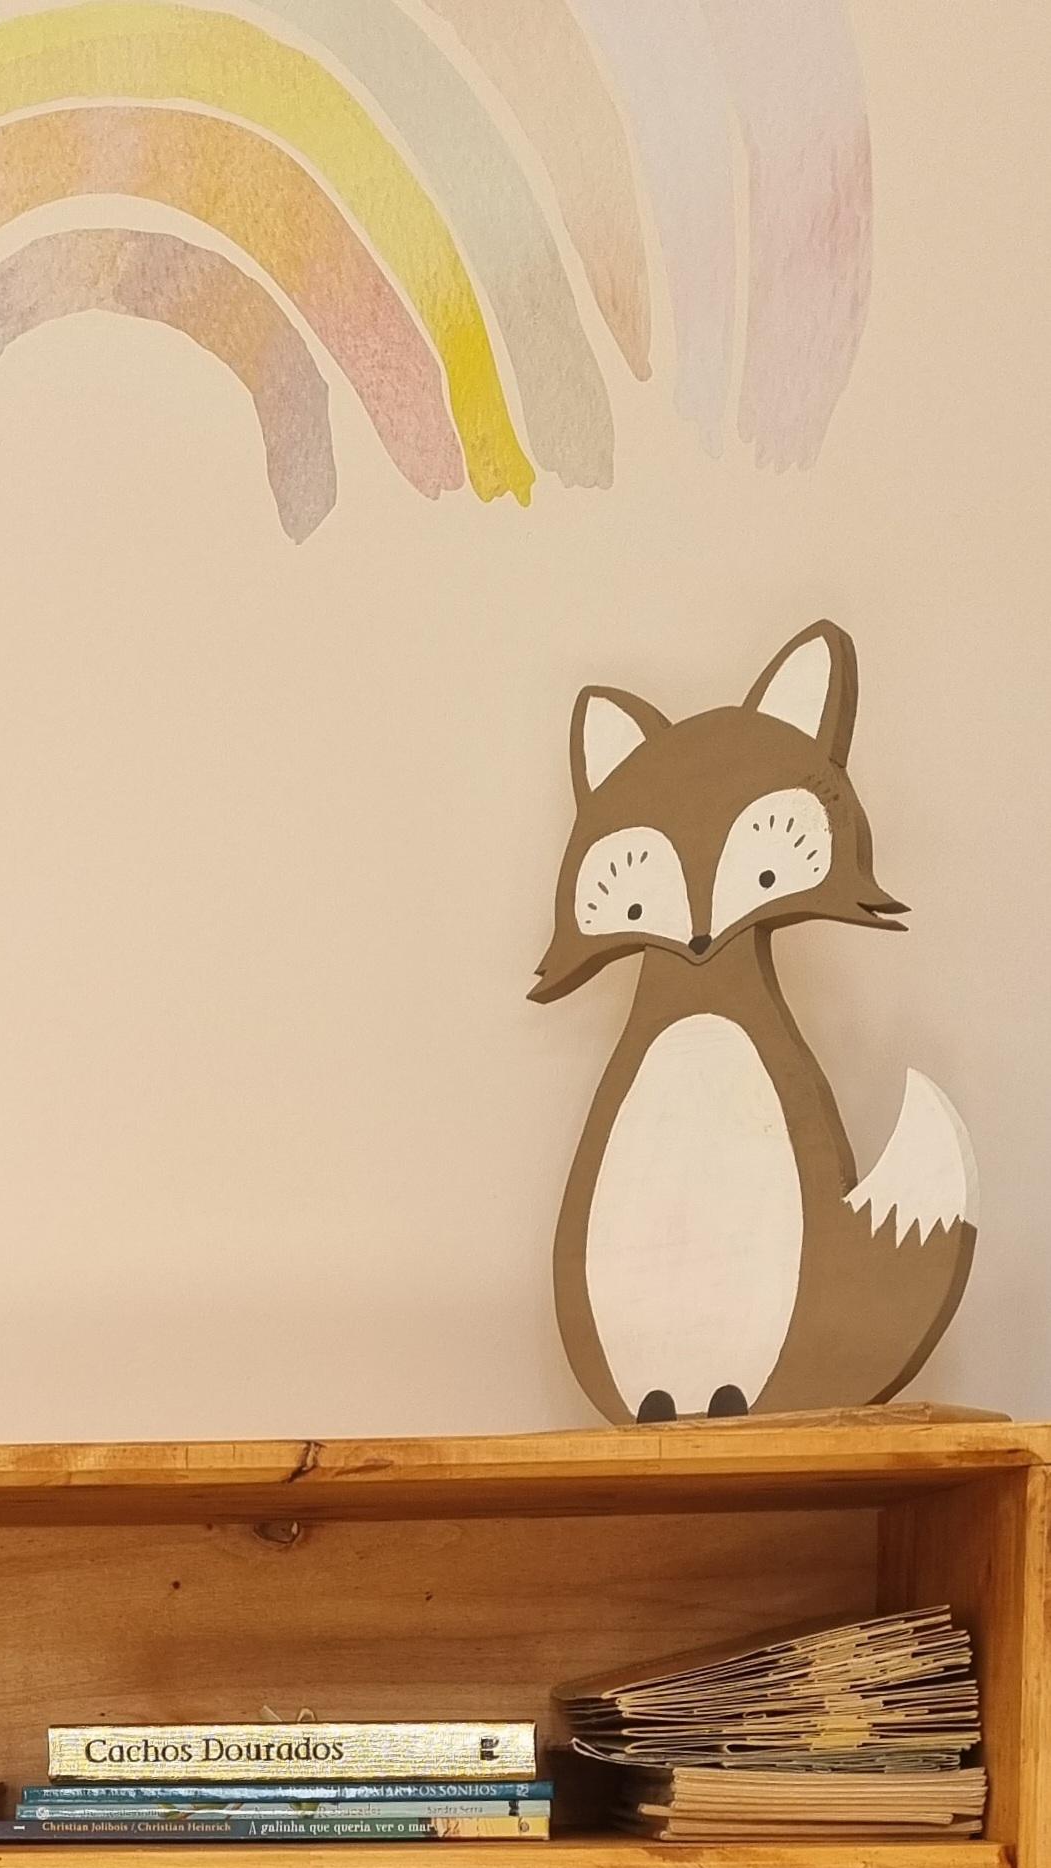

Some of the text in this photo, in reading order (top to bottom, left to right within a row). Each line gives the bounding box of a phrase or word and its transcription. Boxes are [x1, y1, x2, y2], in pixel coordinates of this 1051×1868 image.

[85, 1737, 344, 1763] Cachos Dourados
[439, 1784, 496, 1796] SONHOS
[42, 1822, 88, 1832] Christian
[91, 1822, 128, 1833] Jolibois
[137, 1822, 184, 1832] Christian
[187, 1822, 231, 1832] Heinrich
[249, 1820, 432, 1835] A galinha que queria ver o mar
